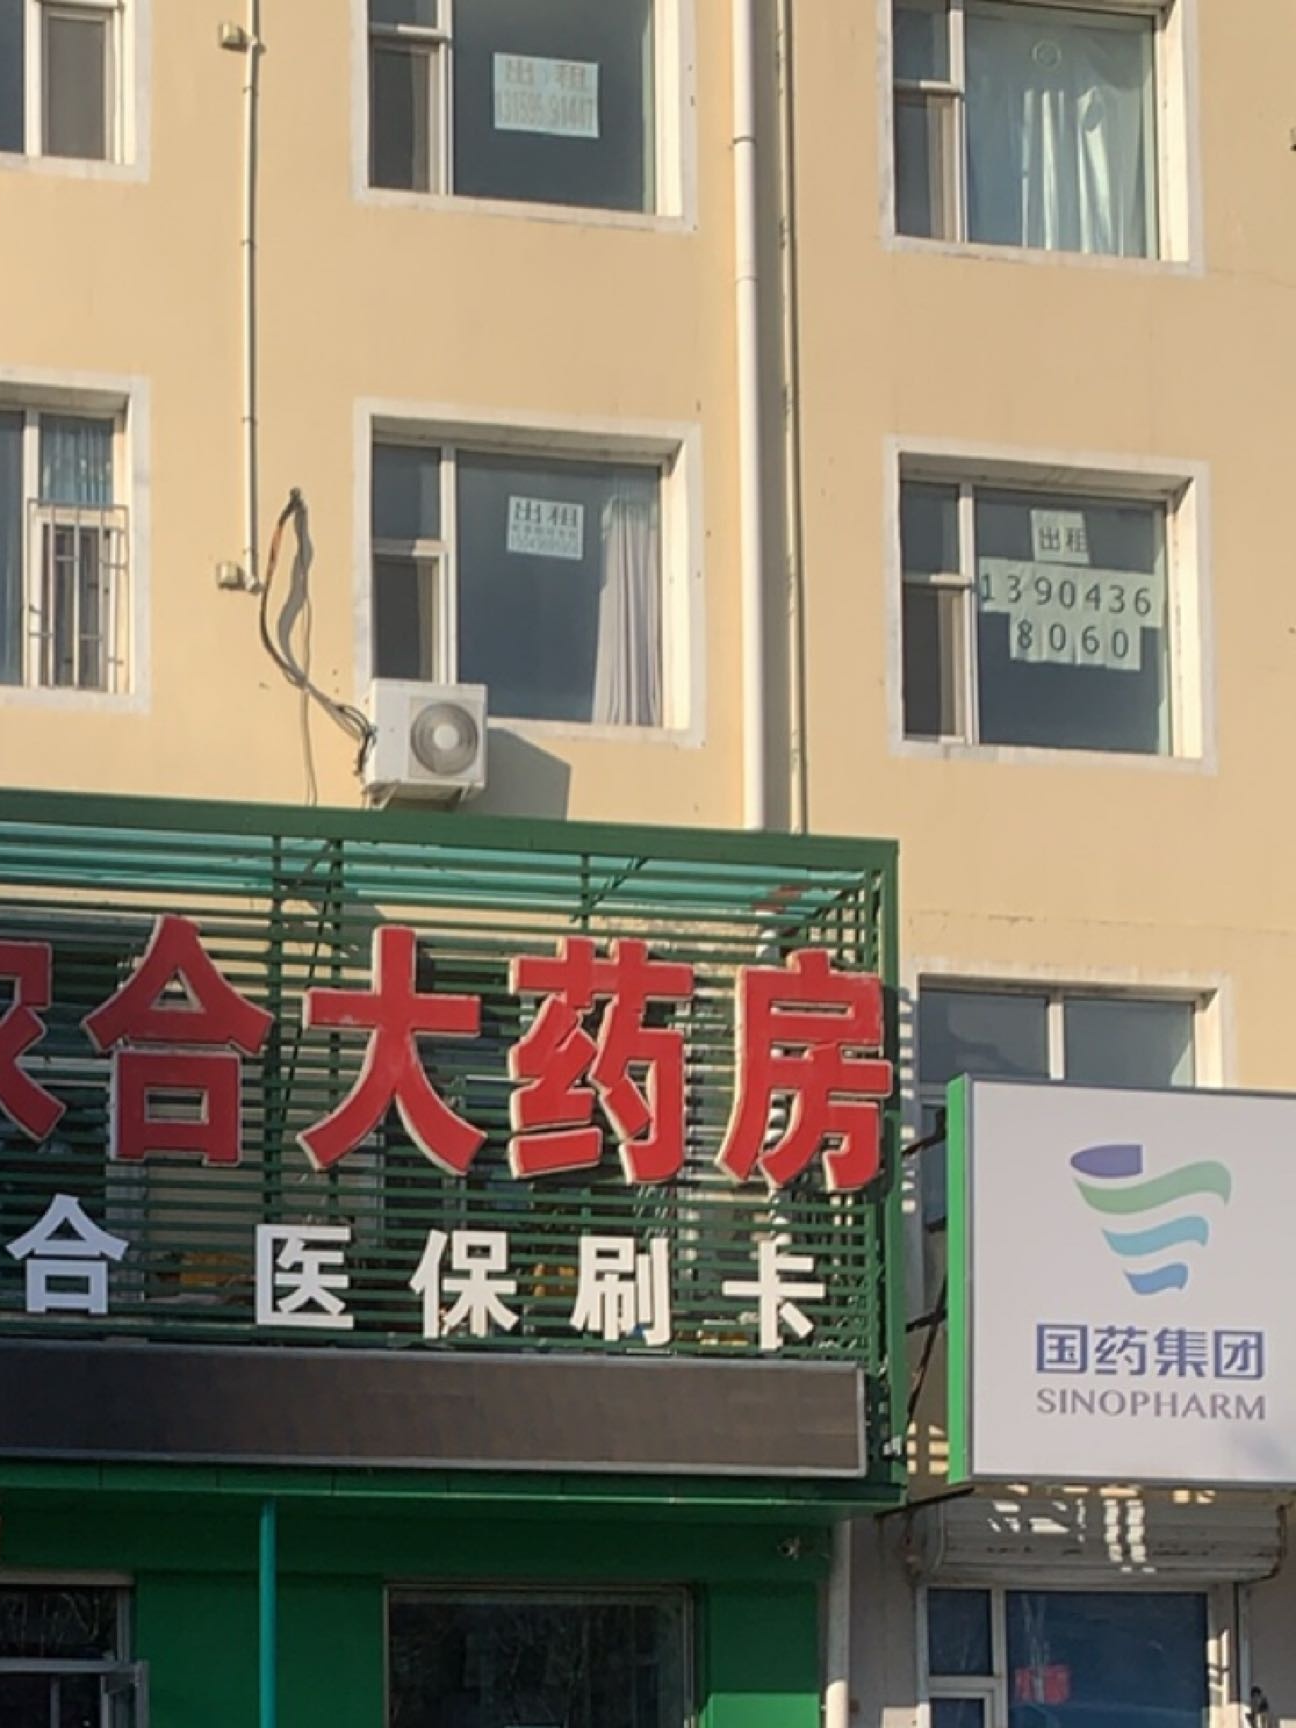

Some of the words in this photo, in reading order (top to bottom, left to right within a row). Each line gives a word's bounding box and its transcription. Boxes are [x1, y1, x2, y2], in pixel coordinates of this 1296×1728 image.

[515, 501, 577, 528] 出租
[1038, 527, 1085, 552] 出租
[981, 574, 1152, 617] 1390436
[1017, 619, 1129, 659] 8060
[255, 1223, 826, 1352] 医保刷卡
[1036, 1324, 1264, 1380] 国药集团
[1036, 1387, 1266, 1420] SINOPHARM
